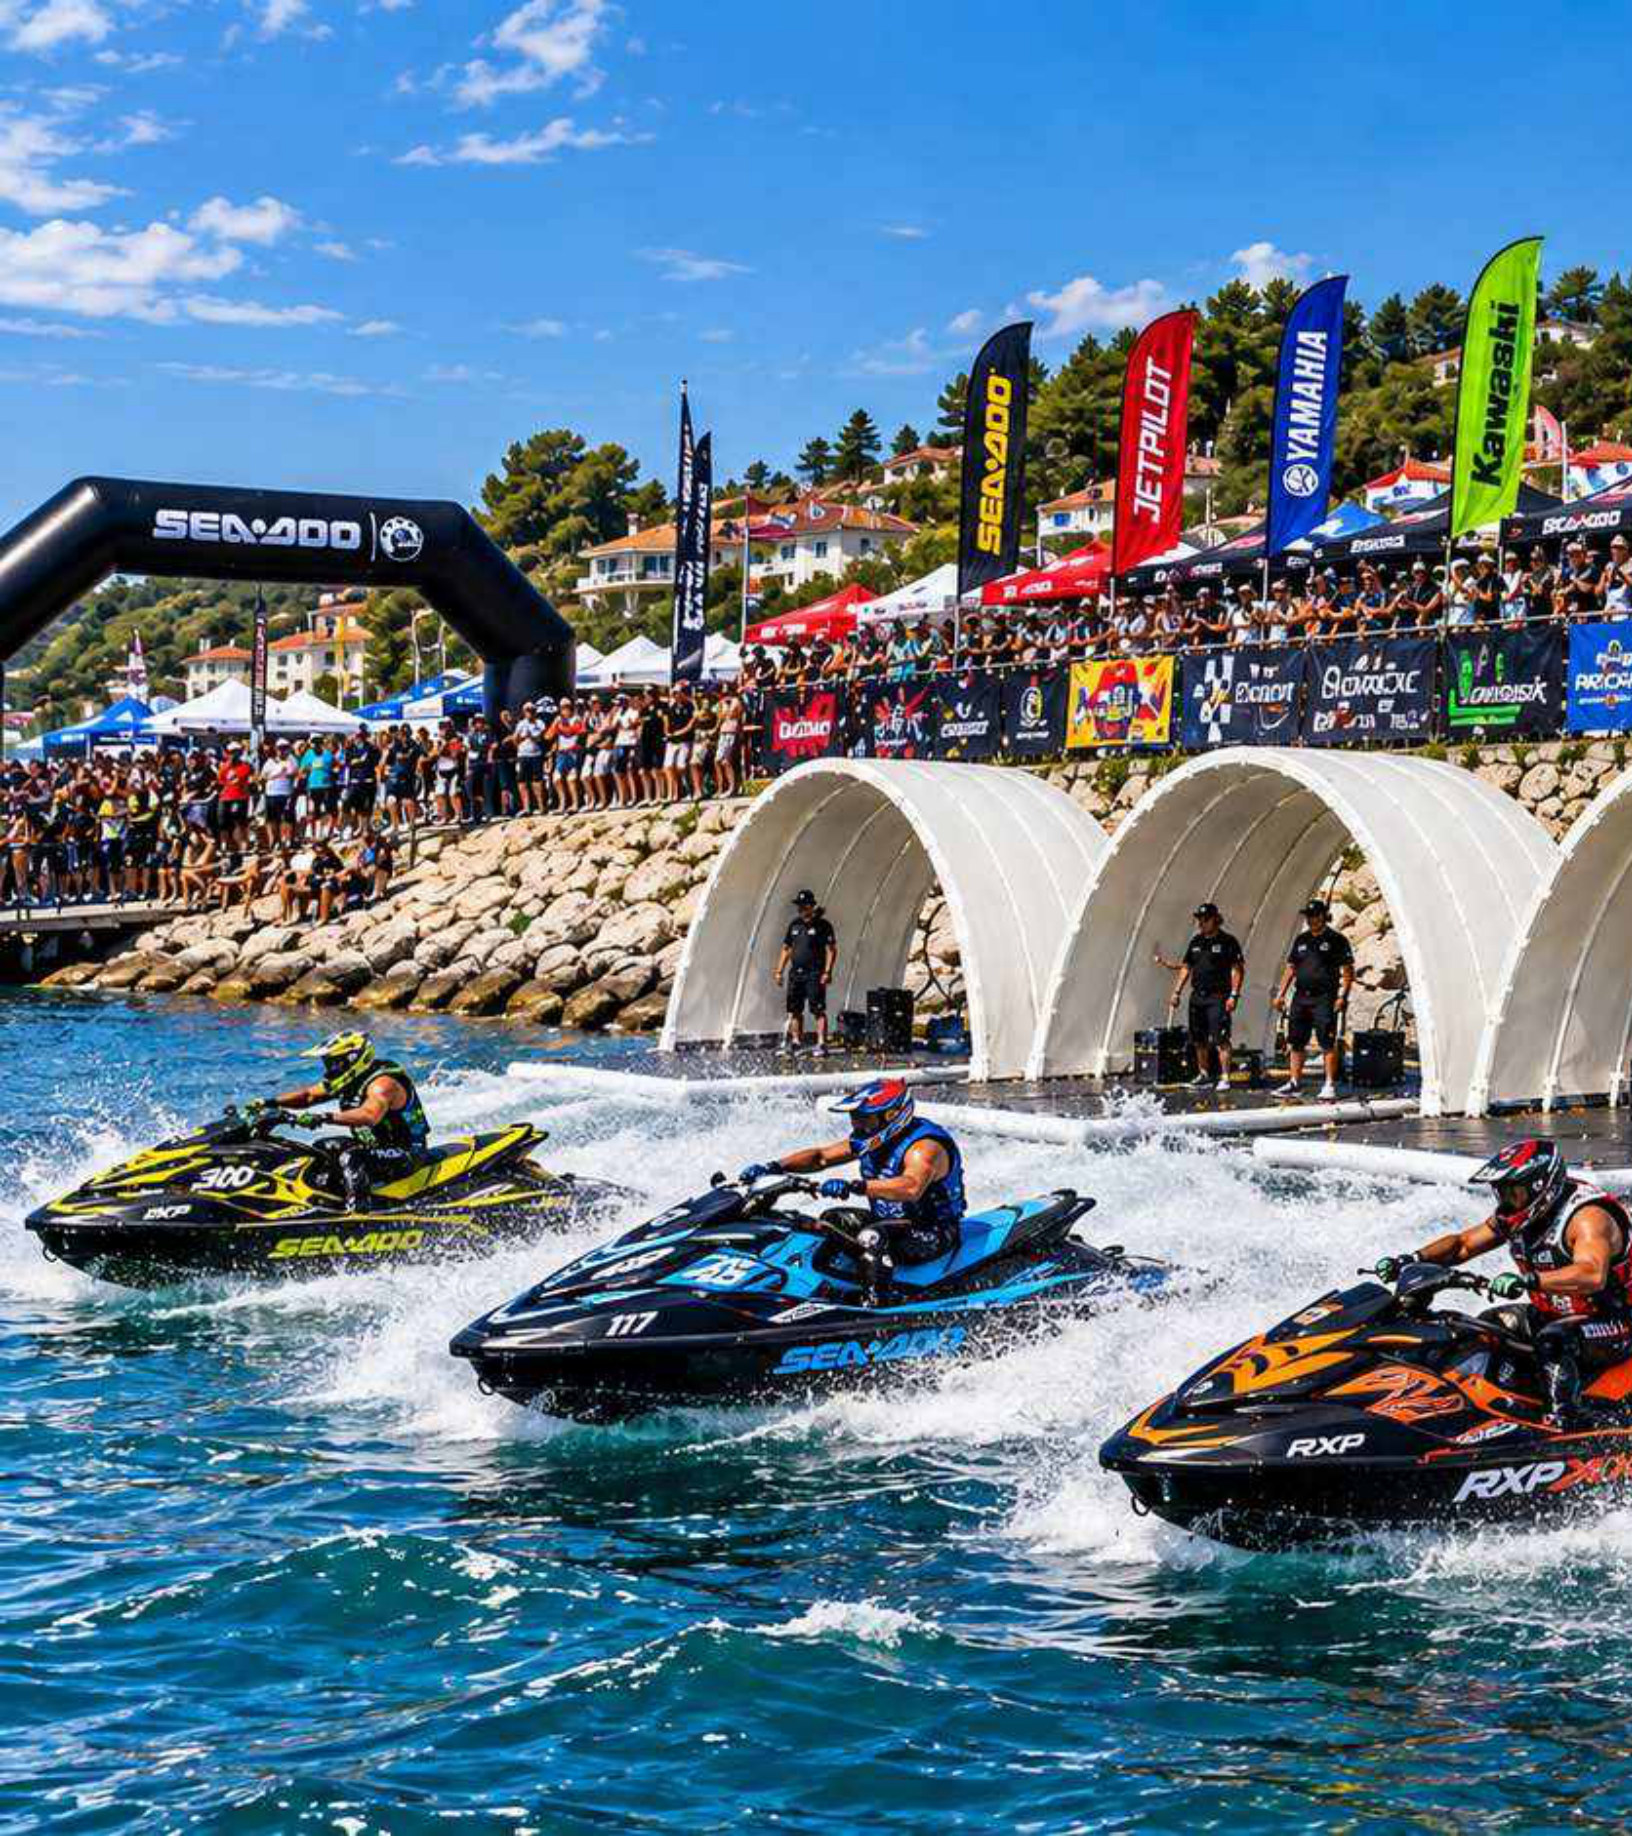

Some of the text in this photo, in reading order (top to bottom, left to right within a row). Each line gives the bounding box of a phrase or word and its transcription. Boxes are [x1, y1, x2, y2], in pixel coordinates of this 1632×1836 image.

[1133, 356, 1172, 524] JETPILOT
[605, 1311, 658, 1337] 117
[1286, 1433, 1366, 1459] RXP
